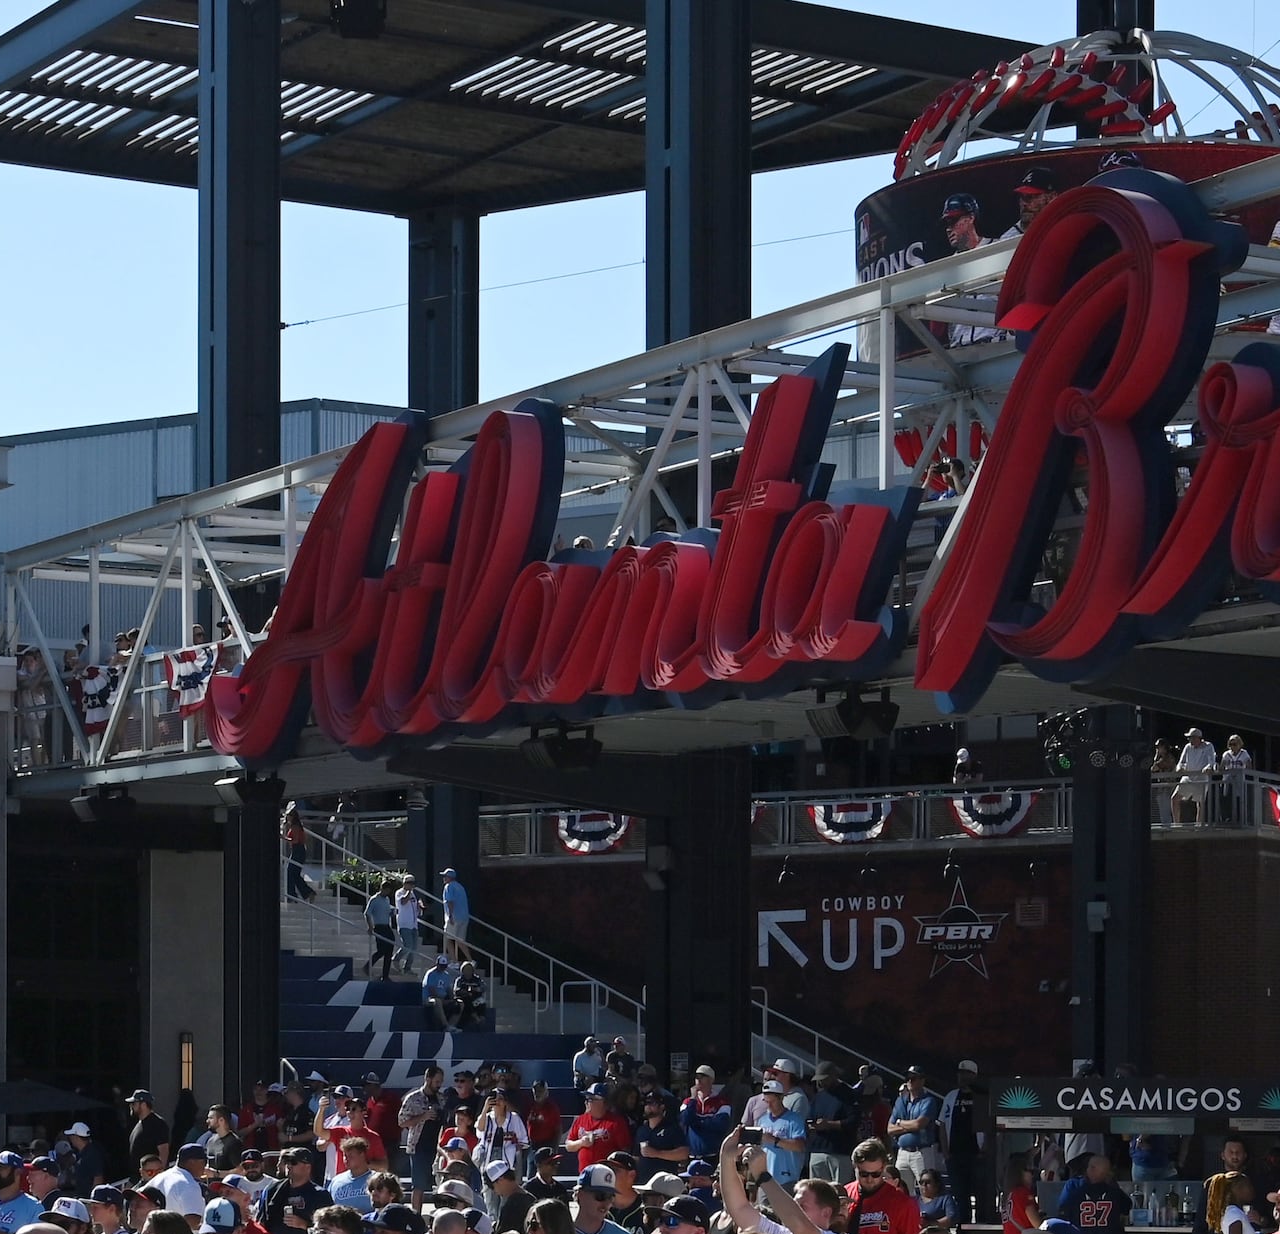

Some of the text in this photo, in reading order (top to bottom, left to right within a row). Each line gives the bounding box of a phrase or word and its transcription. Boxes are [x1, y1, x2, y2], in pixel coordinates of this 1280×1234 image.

[210, 342, 918, 755] Atlanta
[821, 895, 906, 913] COWBOY
[821, 917, 906, 972] UP
[922, 924, 995, 941] PBR
[1056, 1087, 1242, 1112] CASAMIGOS
[1080, 1200, 1113, 1227] 27
